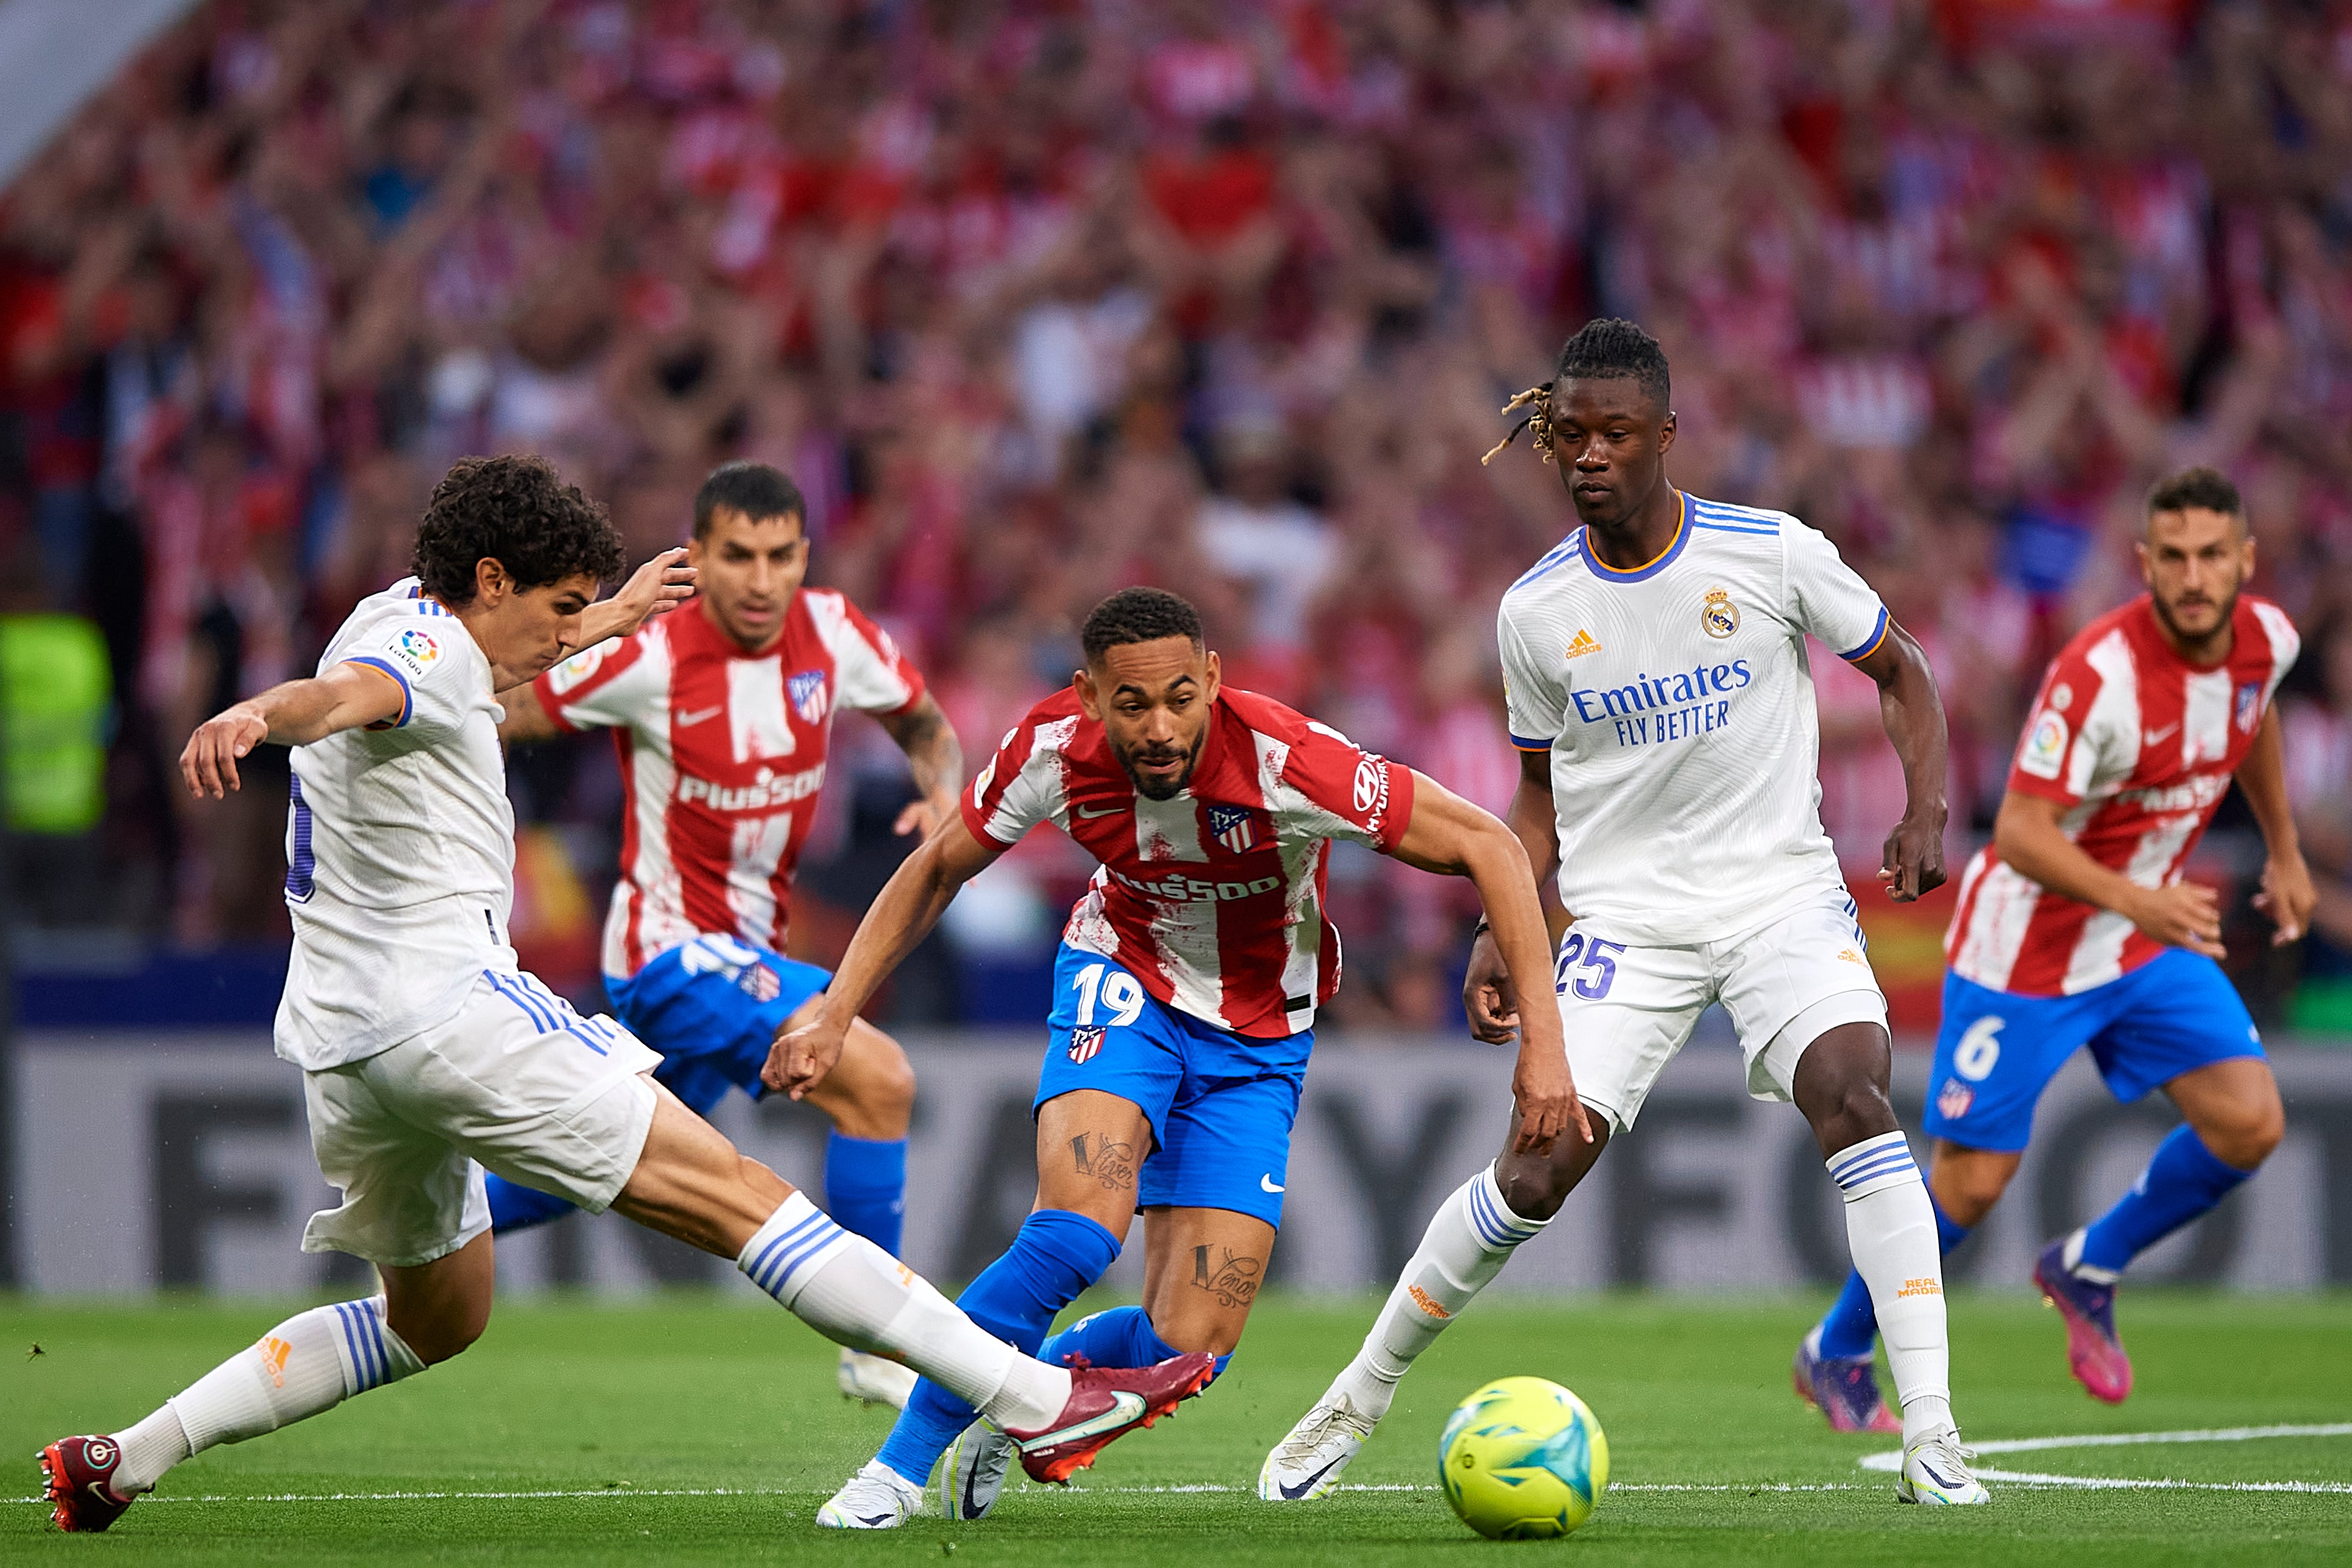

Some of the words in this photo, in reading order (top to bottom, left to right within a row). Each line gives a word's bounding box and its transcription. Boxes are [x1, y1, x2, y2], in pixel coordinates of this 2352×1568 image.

[1565, 643, 1603, 660] adidas
[1570, 658, 1752, 724] Emirates
[1615, 717, 1648, 747] FLY
[1656, 700, 1729, 744] BETTER
[1072, 964, 1146, 1027] 19
[1555, 933, 1628, 1001] 25
[1952, 1014, 2006, 1082] 6
[1905, 1278, 1939, 1288] REAL
